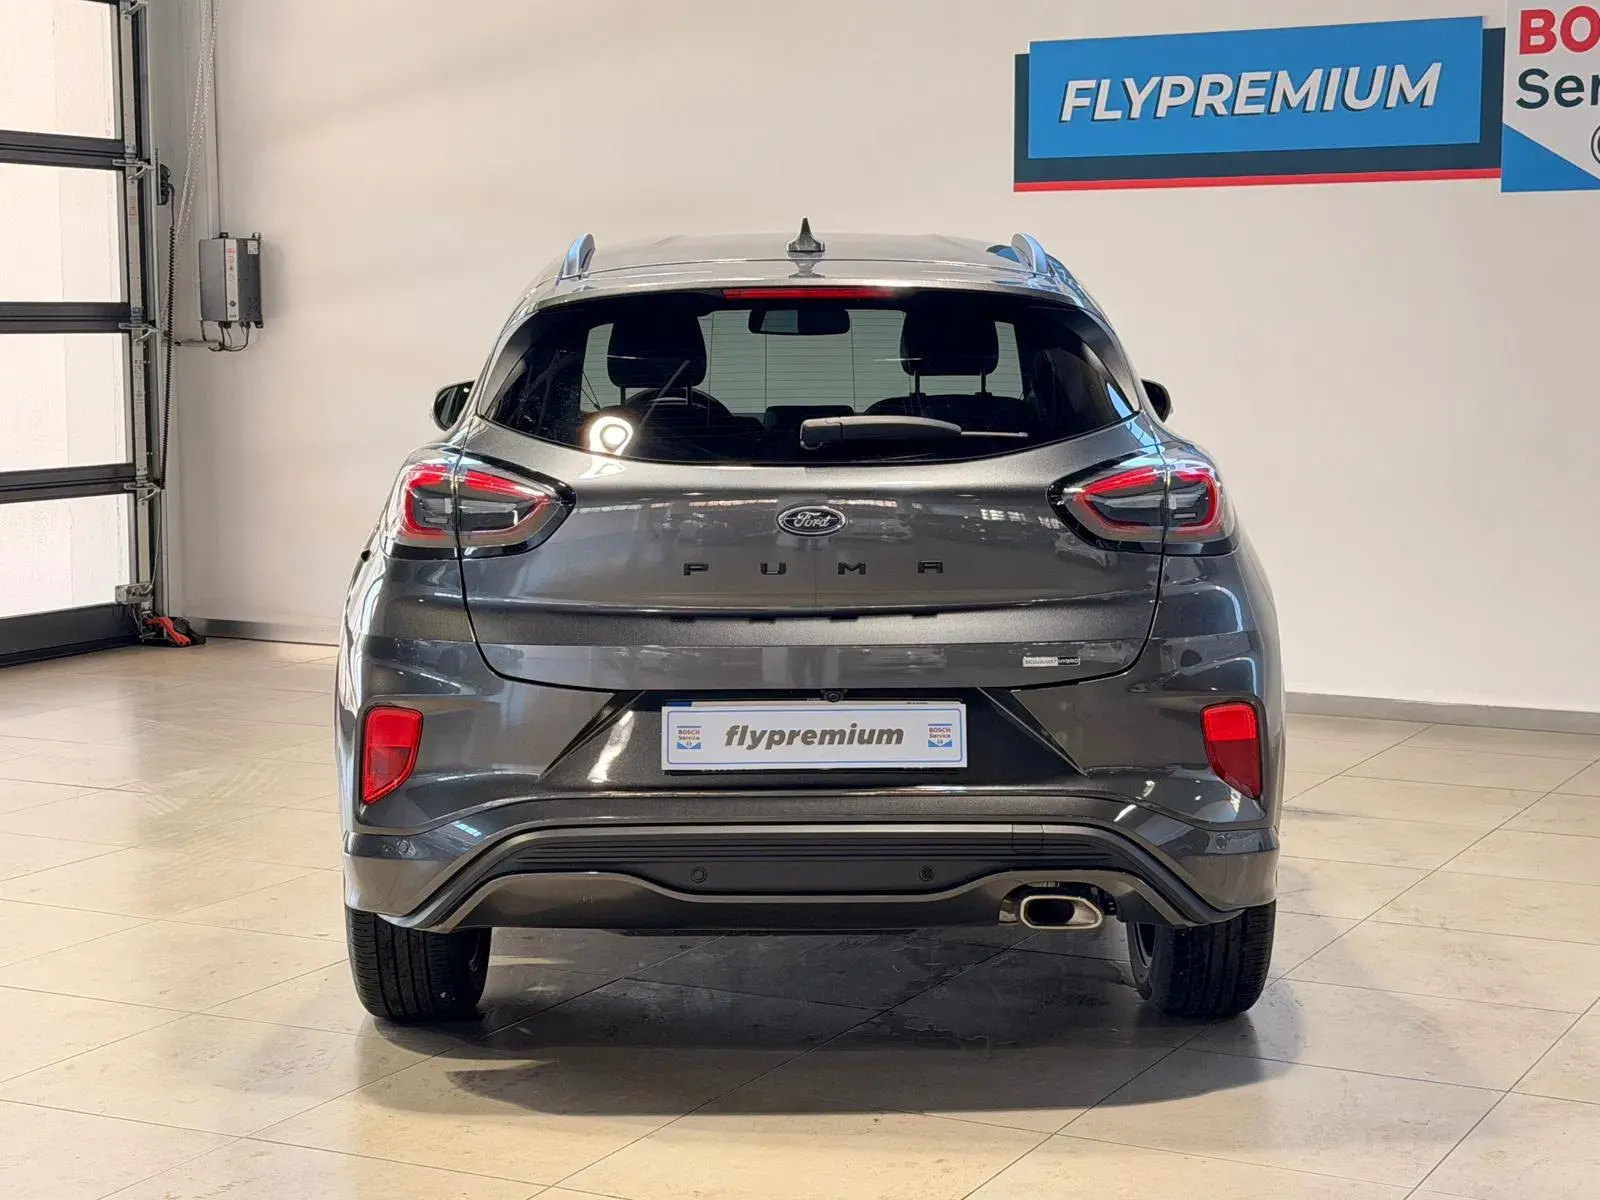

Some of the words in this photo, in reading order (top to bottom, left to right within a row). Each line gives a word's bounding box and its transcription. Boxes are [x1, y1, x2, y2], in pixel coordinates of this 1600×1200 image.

[1519, 6, 1600, 54] BO
[1059, 63, 1442, 124] FLYPREMIUM
[794, 511, 830, 528] Ford
[684, 561, 943, 575] PUMA
[724, 722, 904, 750] flypremium
